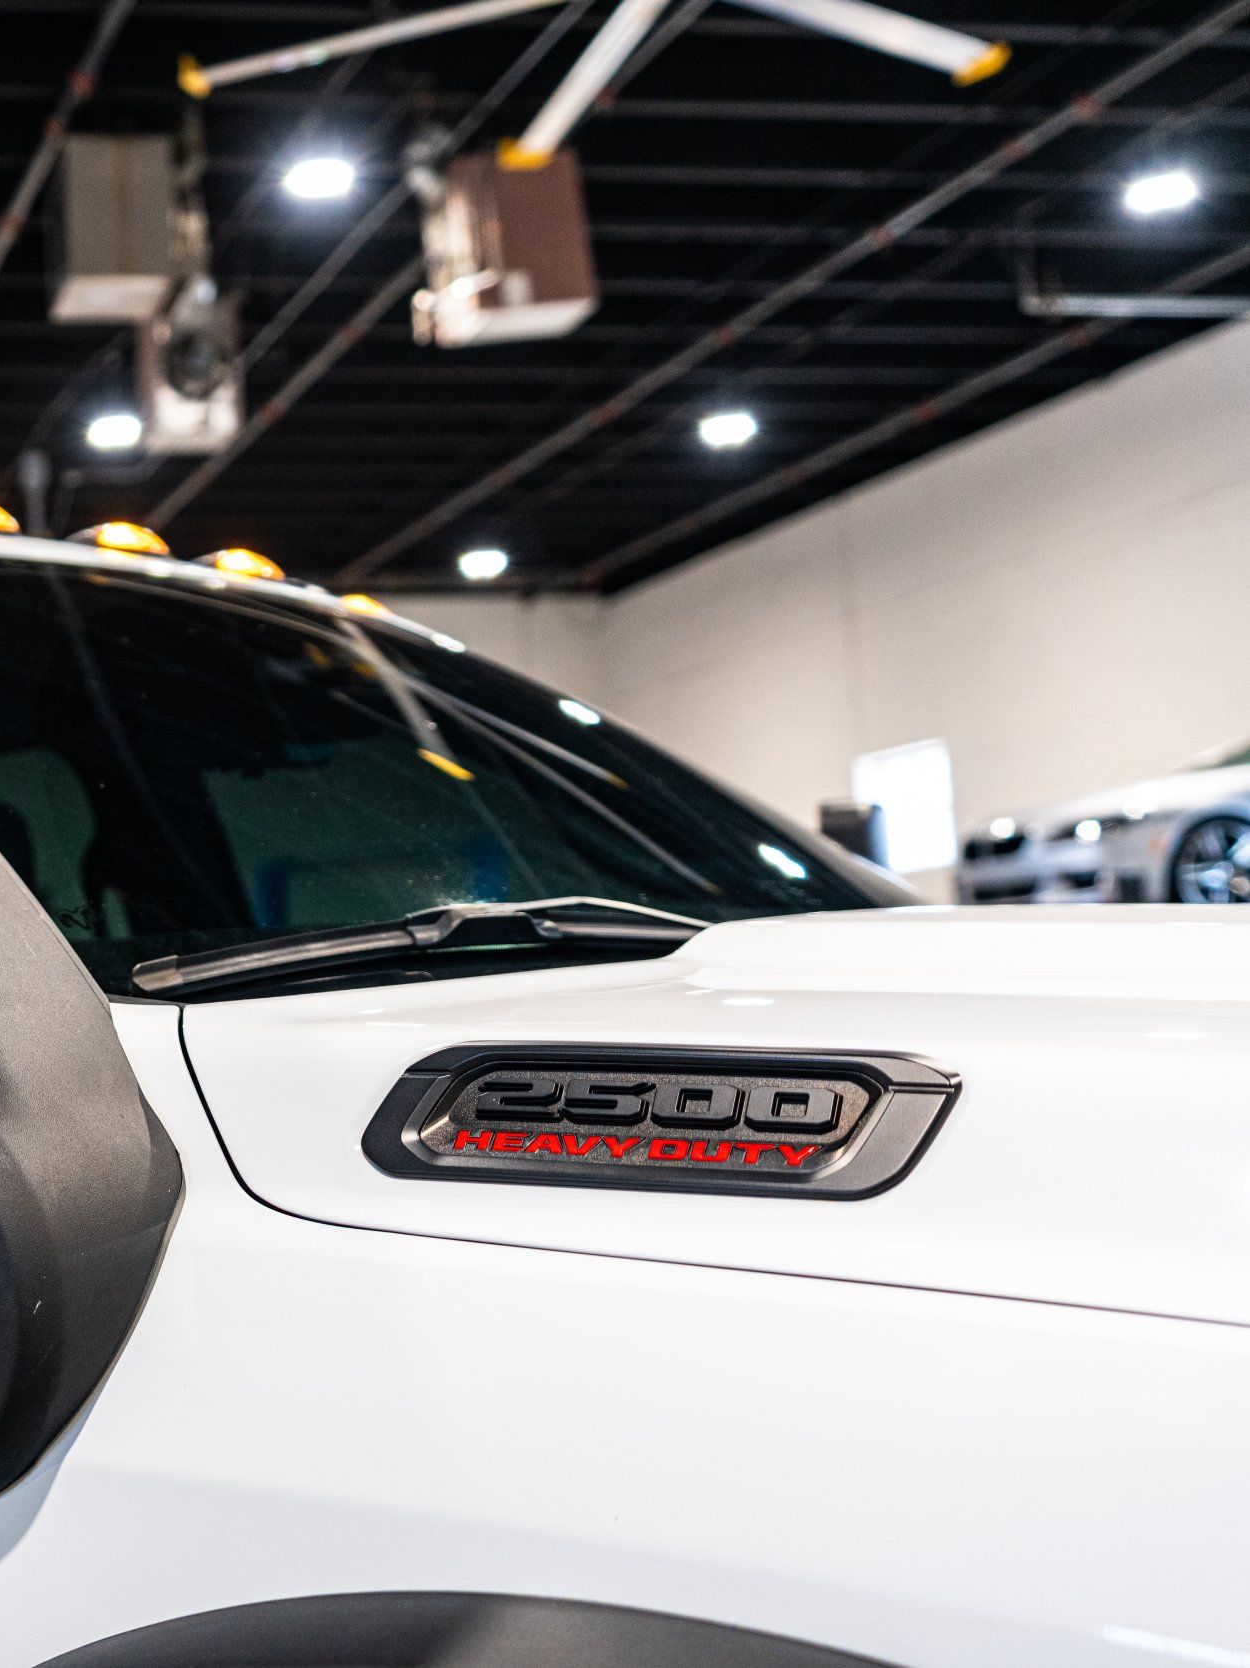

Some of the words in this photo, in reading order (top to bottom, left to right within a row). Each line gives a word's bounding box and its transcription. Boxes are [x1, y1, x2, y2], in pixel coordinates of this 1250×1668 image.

[476, 1078, 843, 1132] 2500
[453, 1131, 643, 1158] HEAVY
[648, 1138, 821, 1167] DUTY
